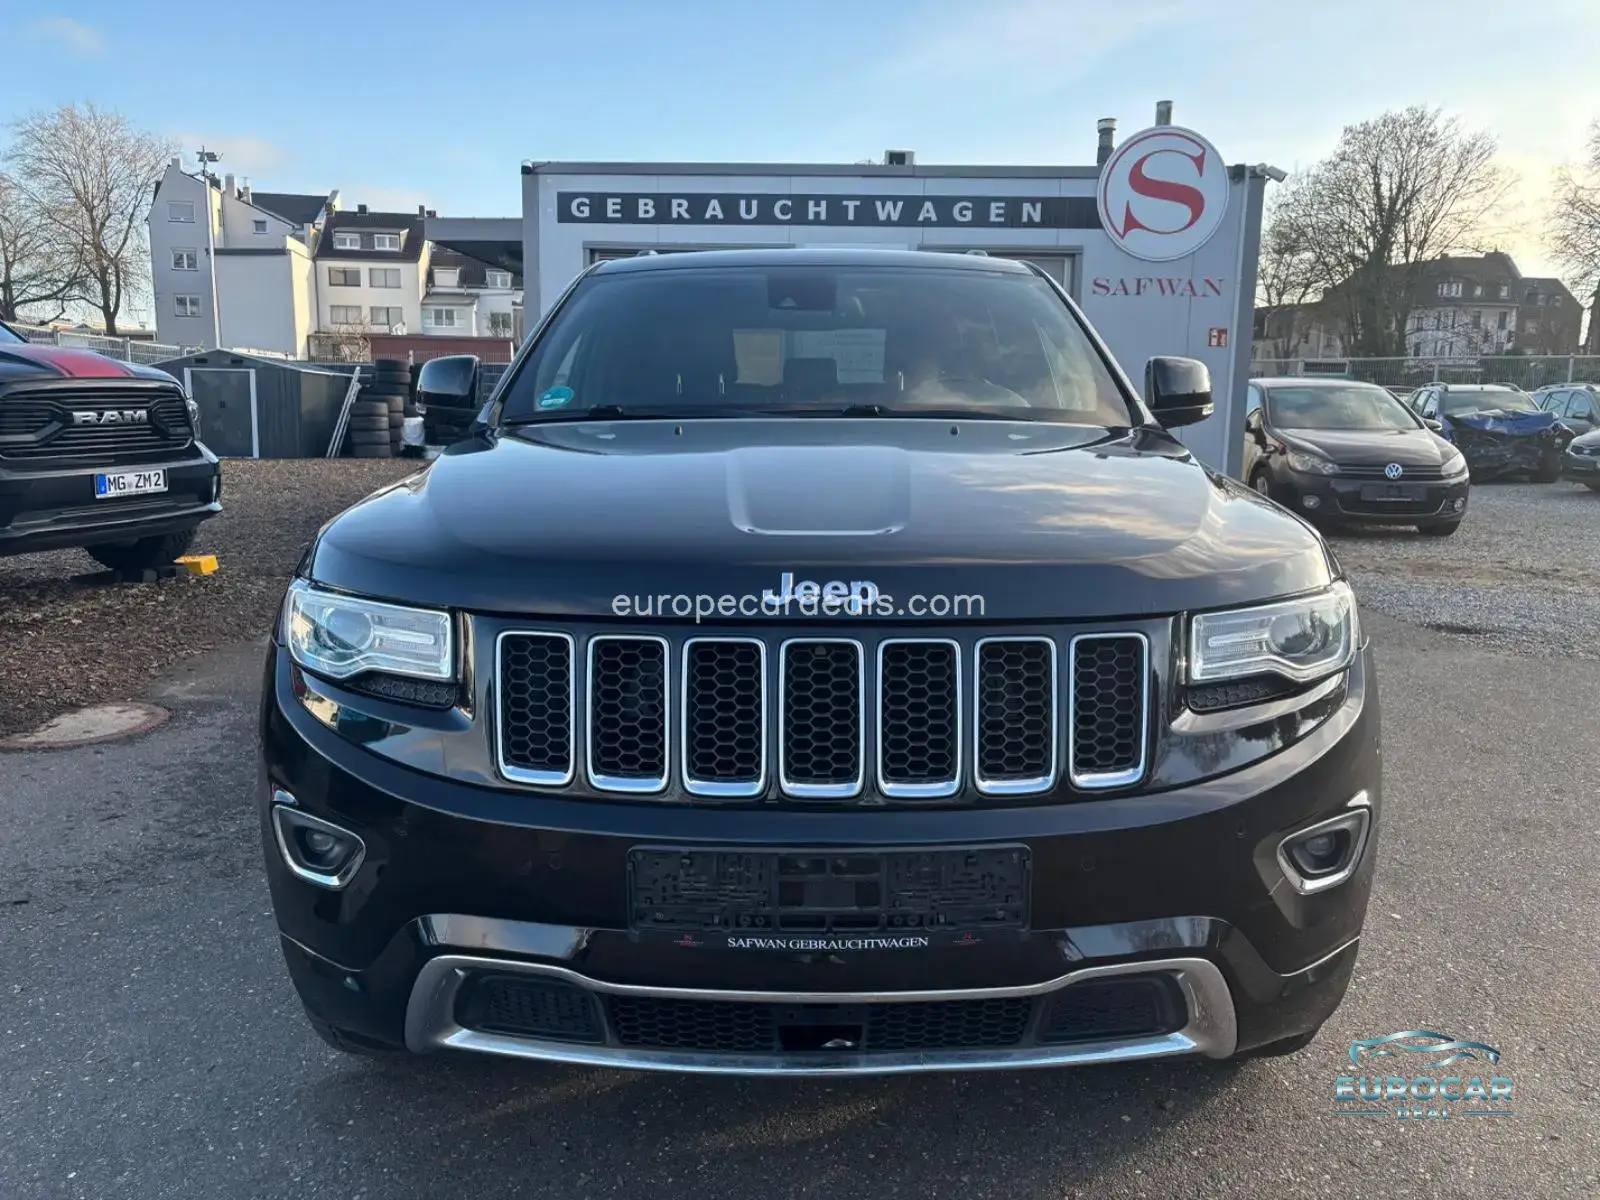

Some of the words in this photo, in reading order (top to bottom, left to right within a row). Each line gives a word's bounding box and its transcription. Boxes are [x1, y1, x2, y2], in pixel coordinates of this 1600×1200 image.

[1104, 132, 1206, 240] S
[571, 197, 1042, 223] GEBRAUCHTWAGEN
[1092, 276, 1224, 297] SAFWAN
[72, 410, 148, 425] RAM
[107, 475, 126, 492] MG
[135, 473, 152, 489] ZM
[762, 572, 879, 613] Jeep
[727, 936, 786, 949] SAFWAN
[789, 936, 929, 950] GEBRAUCHTWAGEN
